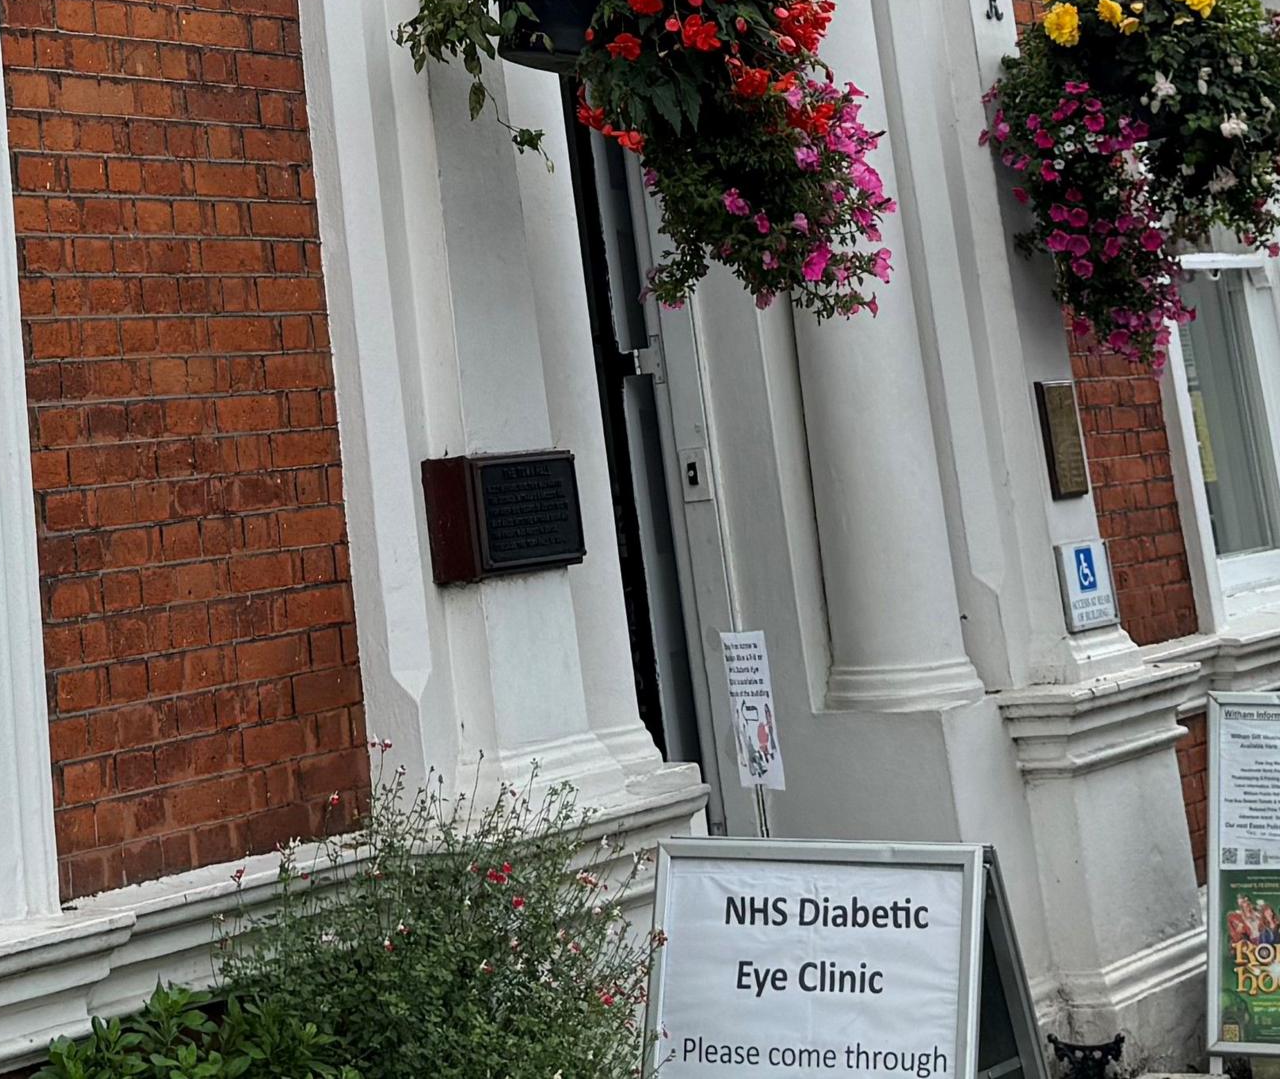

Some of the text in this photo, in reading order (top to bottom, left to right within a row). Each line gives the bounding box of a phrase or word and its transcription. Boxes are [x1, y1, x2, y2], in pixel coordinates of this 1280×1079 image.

[1224, 710, 1255, 720] Witham
[725, 896, 929, 928] NHS Diabetic
[737, 960, 883, 997] Eye Clinic
[683, 1036, 947, 1078] Please come through
